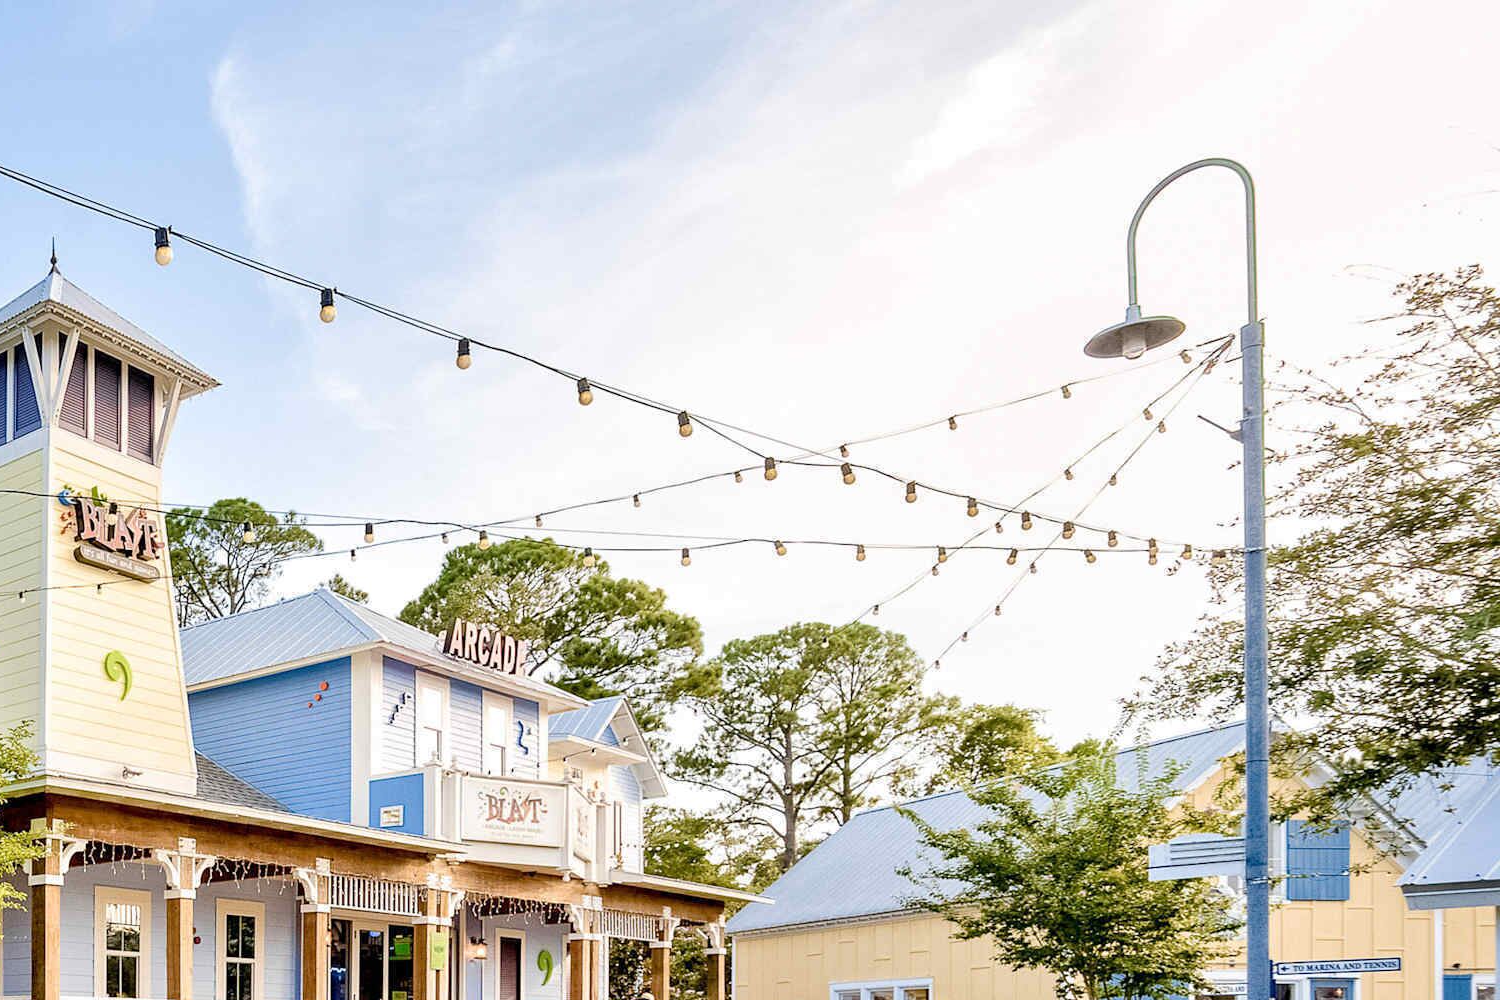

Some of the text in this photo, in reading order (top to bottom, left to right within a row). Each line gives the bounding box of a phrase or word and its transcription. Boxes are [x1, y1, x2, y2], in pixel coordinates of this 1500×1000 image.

[77, 498, 158, 561] BLAST
[485, 793, 542, 824] BLAST
[1306, 963, 1341, 972] MARINA
[1343, 962, 1362, 970] AND
[1363, 960, 1397, 969] TENNIS
